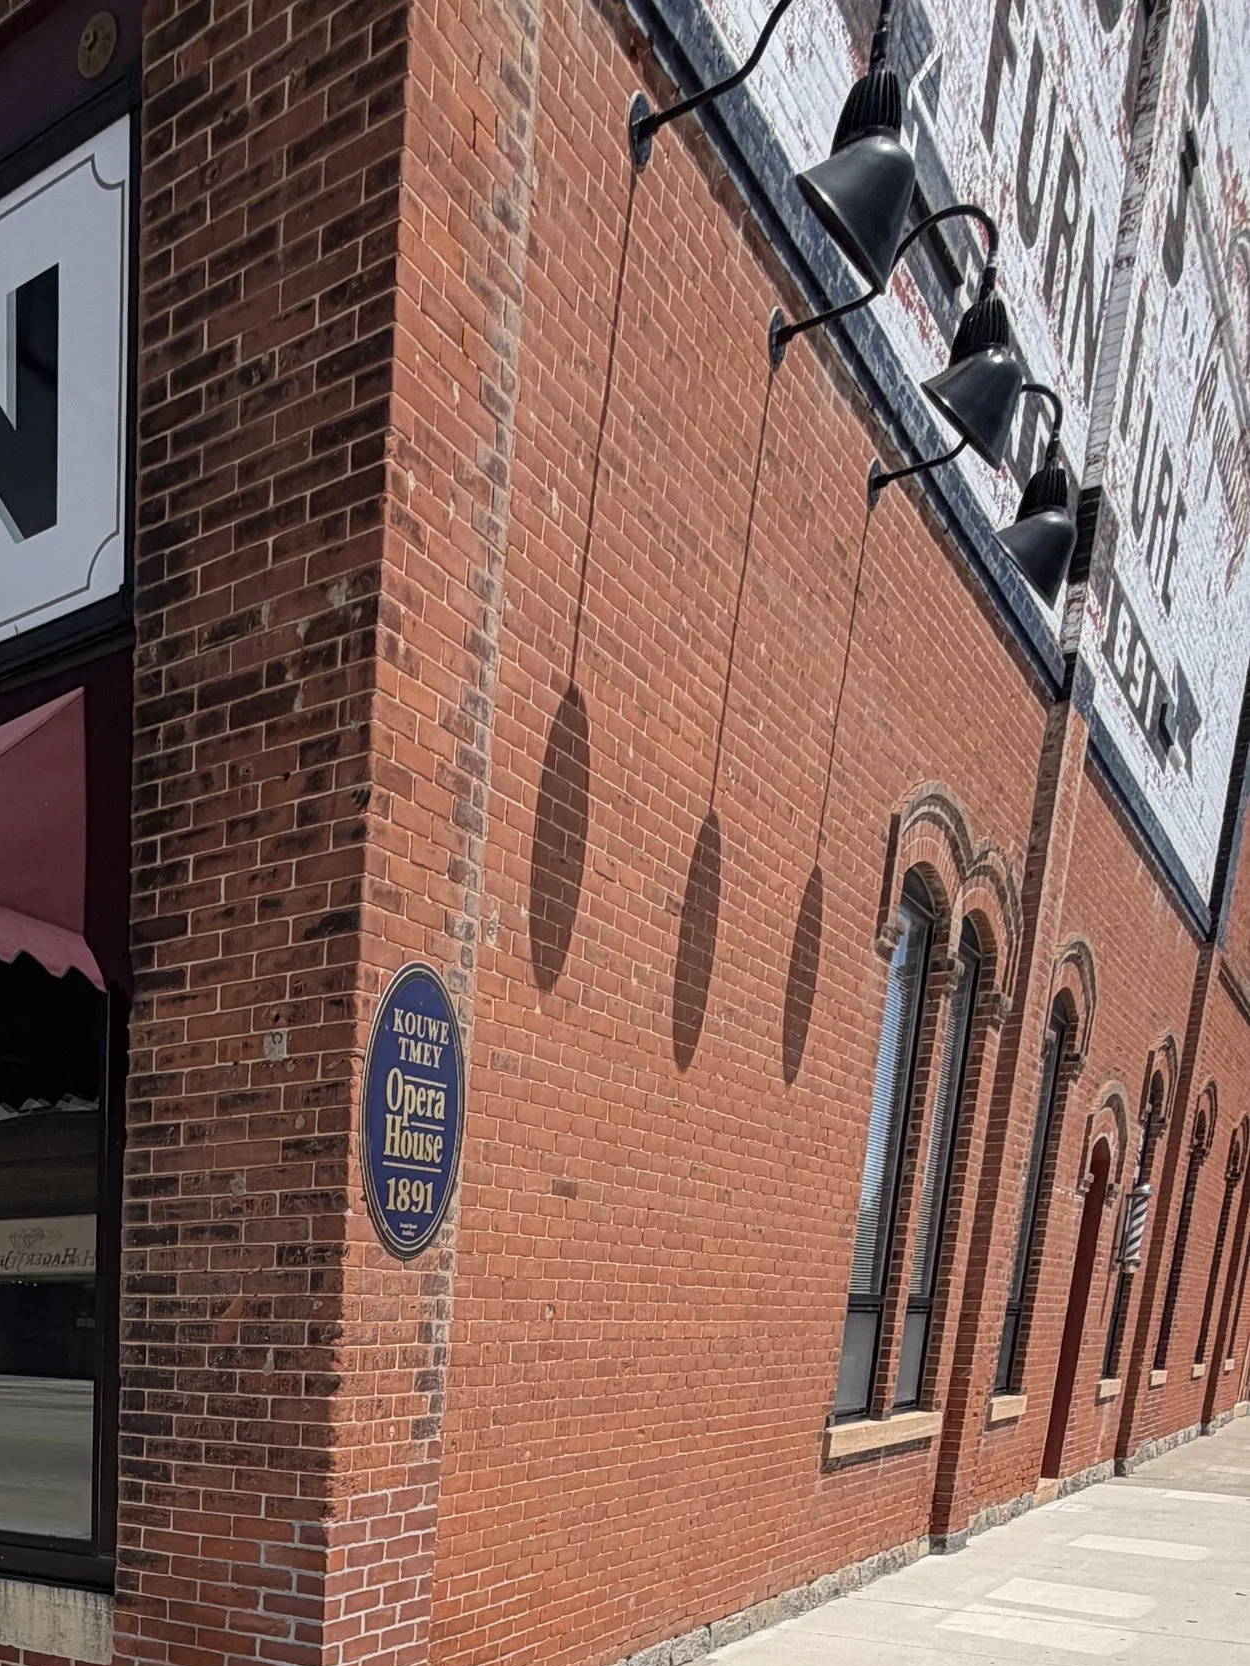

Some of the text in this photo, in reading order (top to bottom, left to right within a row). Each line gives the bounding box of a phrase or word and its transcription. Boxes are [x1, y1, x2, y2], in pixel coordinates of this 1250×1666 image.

[1103, 578, 1157, 731] 1891
[392, 1007, 449, 1045] KOUWE
[398, 1036, 443, 1069] TMEY
[386, 1067, 446, 1126] Opera
[383, 1114, 444, 1164] House
[386, 1177, 434, 1214] 1891
